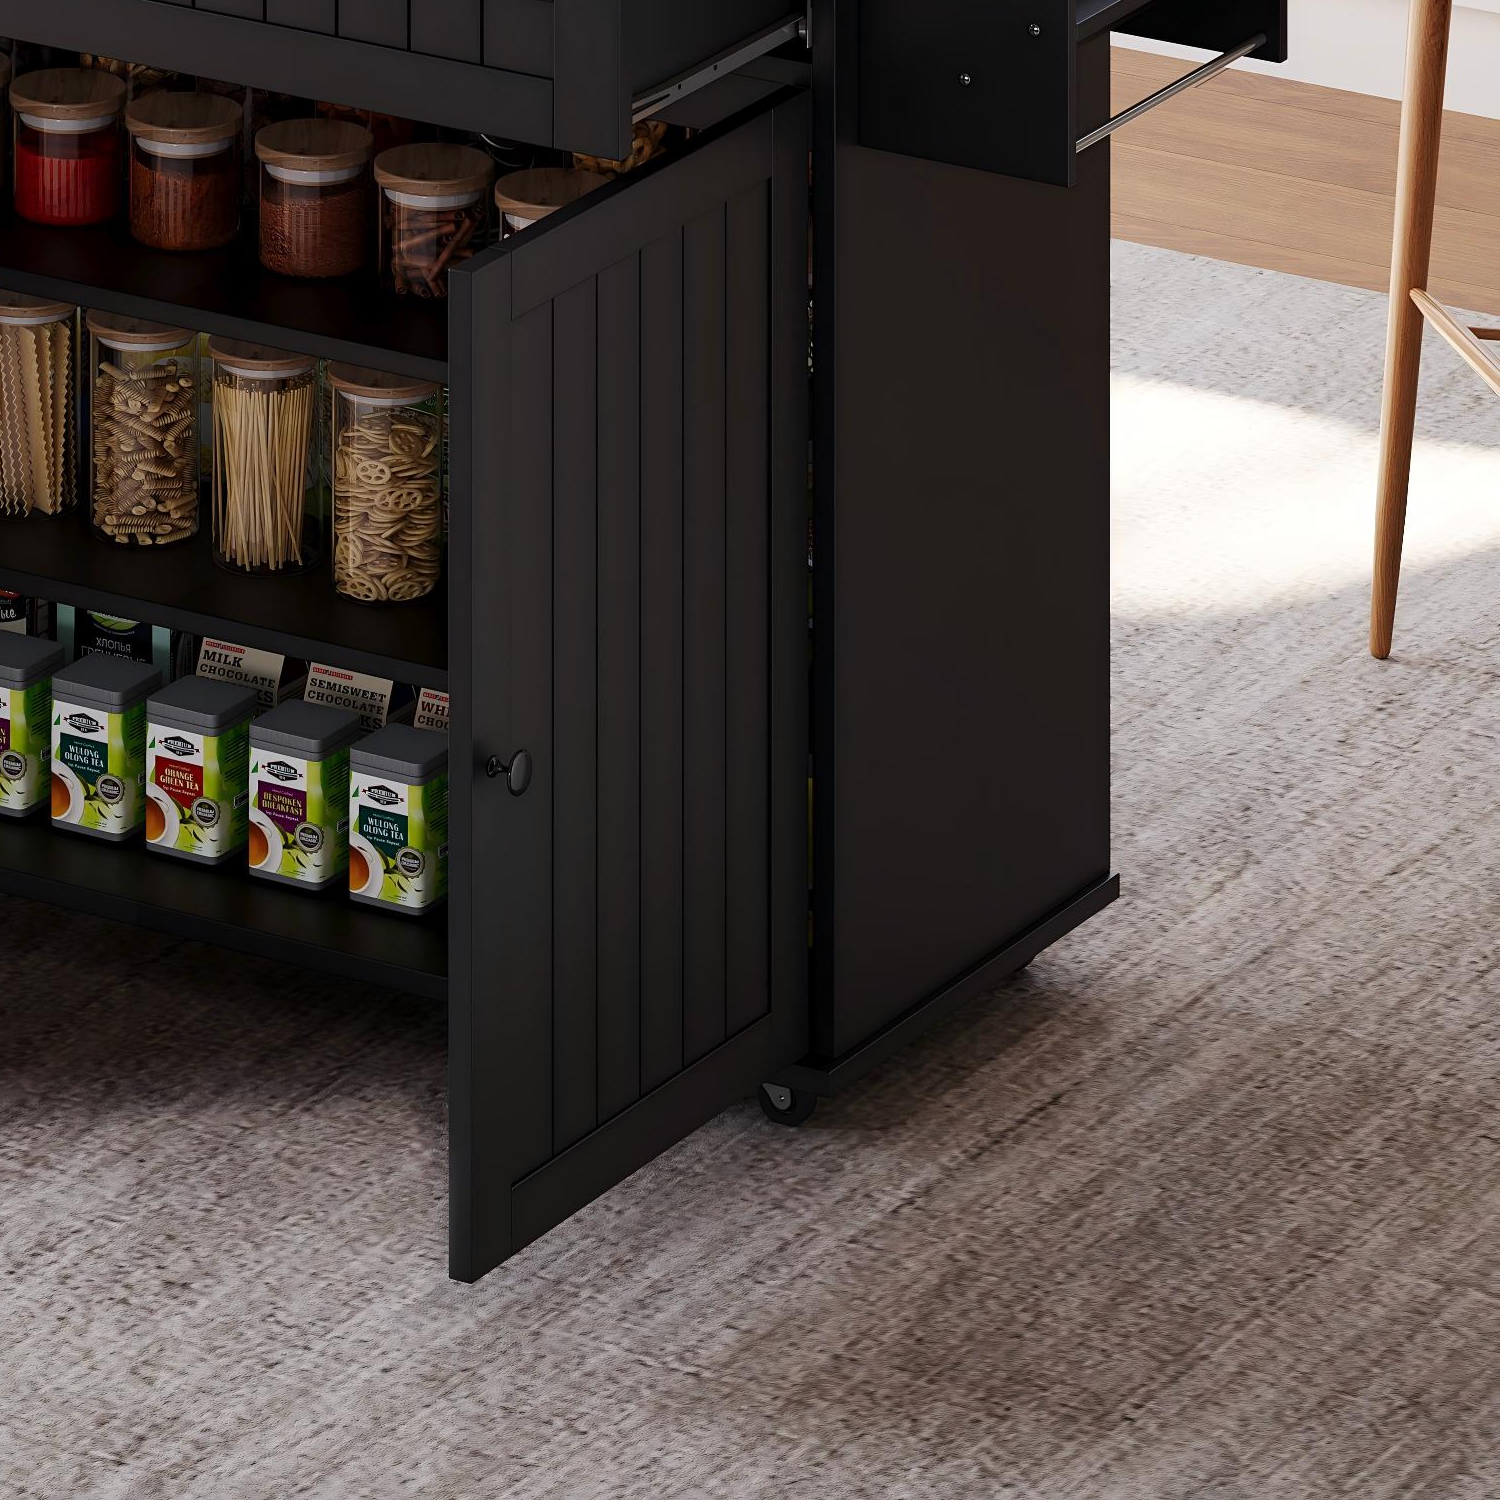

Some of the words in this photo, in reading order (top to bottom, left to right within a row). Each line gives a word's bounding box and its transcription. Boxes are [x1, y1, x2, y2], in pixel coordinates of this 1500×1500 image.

[203, 649, 244, 668] MILK
[199, 663, 276, 689] CHOCOLATE
[309, 677, 387, 703] SEMISWEET
[307, 690, 384, 715] CHOCOLATE
[72, 716, 97, 726] PREMIUM
[68, 745, 100, 759] WULONG
[167, 739, 192, 749] PREMIUM
[64, 751, 89, 764] OLONG
[90, 757, 104, 768] TEA
[164, 768, 194, 782] ORANGE
[270, 763, 295, 774] PREMIUM
[160, 774, 184, 787] GREEN
[185, 780, 199, 791] TEA
[263, 791, 302, 808] BESPOKEN
[371, 788, 396, 798] PREMIUM
[262, 799, 303, 816] BREAKFAST
[363, 824, 389, 837] OLONG
[390, 830, 404, 841] TEA
[367, 816, 399, 832] WULONG
